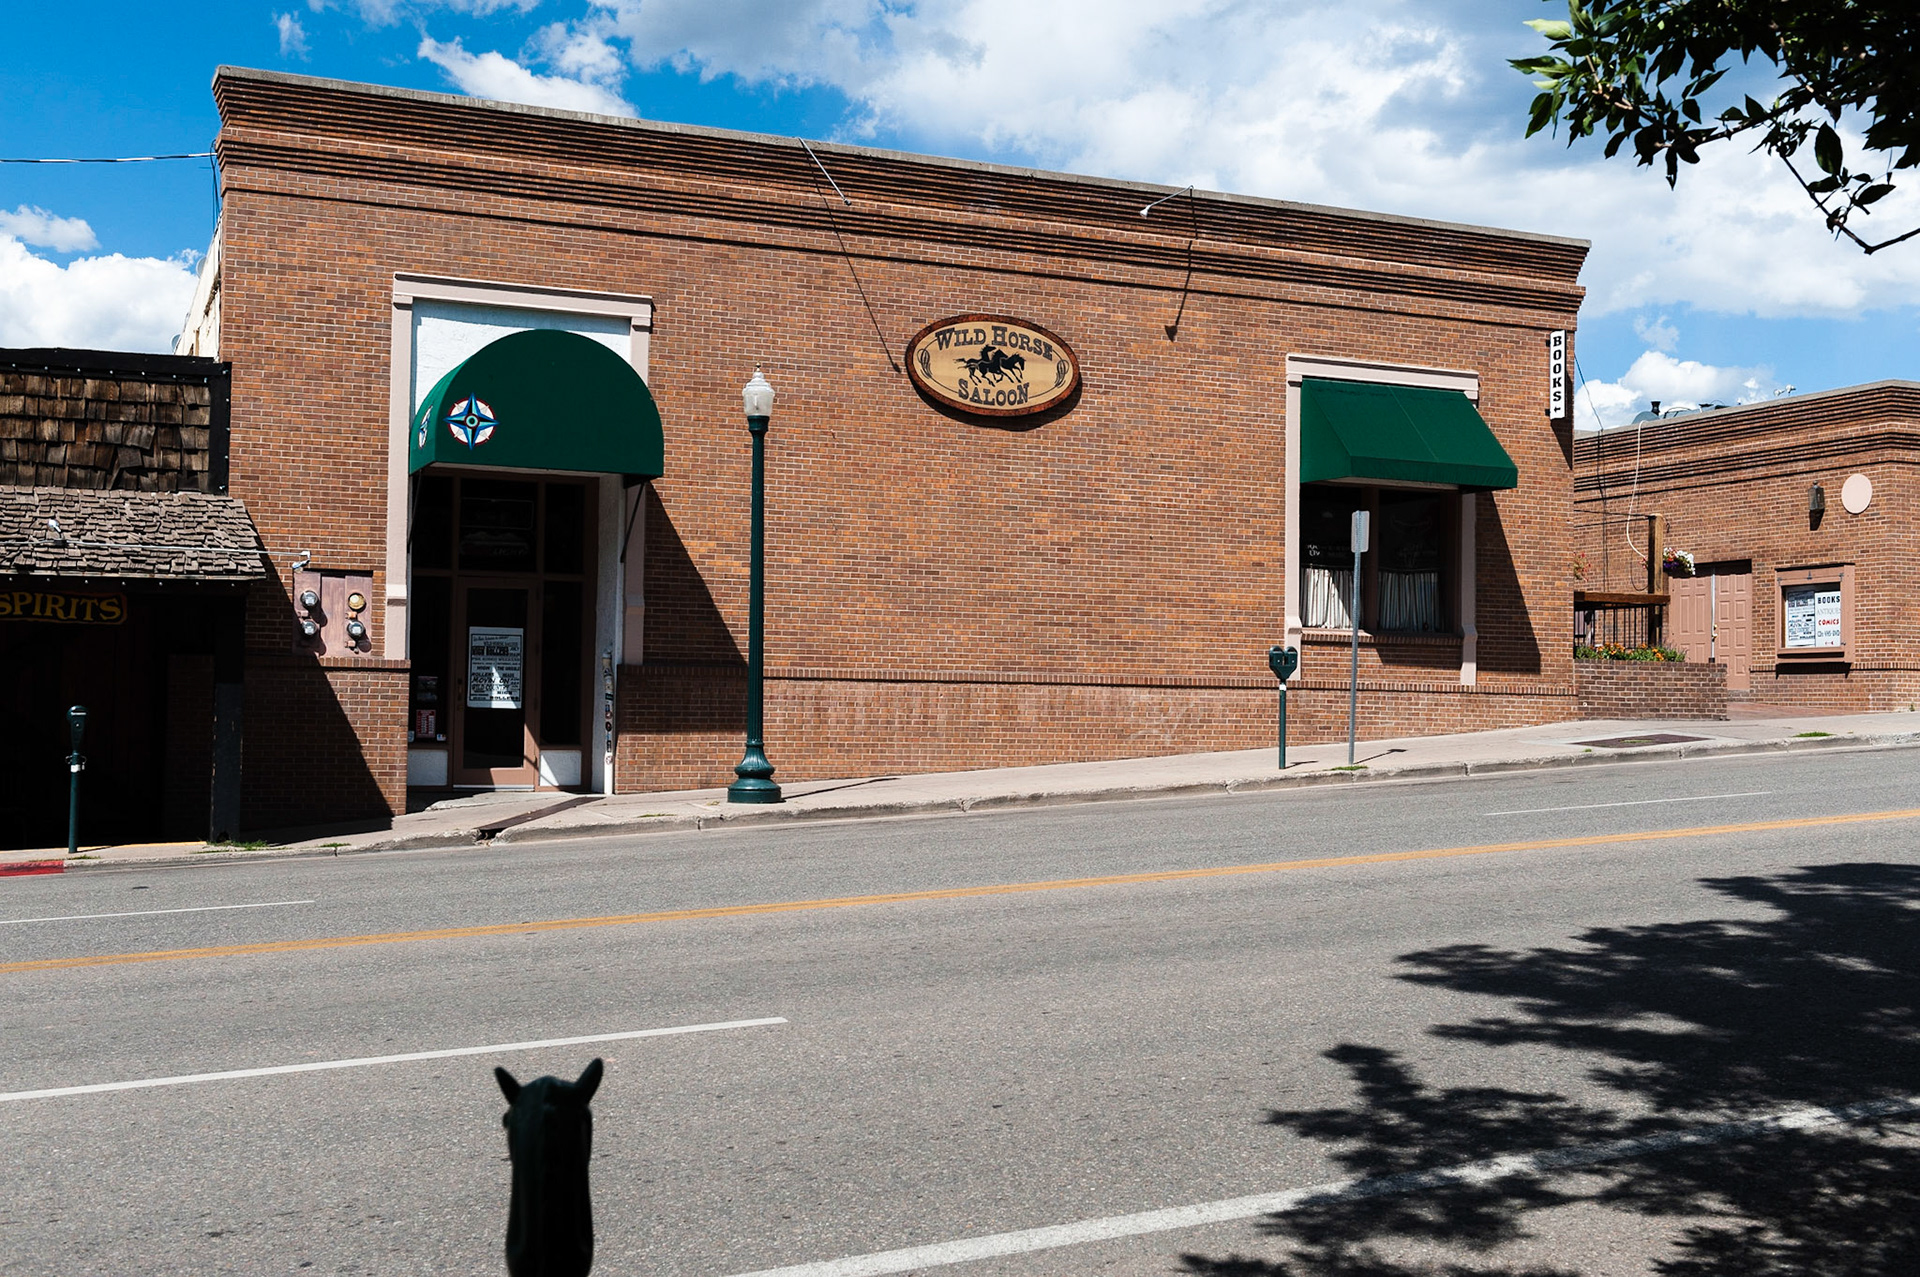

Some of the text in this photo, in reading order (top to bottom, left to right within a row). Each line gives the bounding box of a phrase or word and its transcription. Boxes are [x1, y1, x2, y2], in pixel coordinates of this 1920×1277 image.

[935, 325, 1053, 361] WILD HORSE
[1553, 336, 1562, 402] BOOKS
[957, 378, 1030, 406] SALOON
[0, 591, 121, 620] SPIRITS
[1818, 596, 1840, 604] BOOKS
